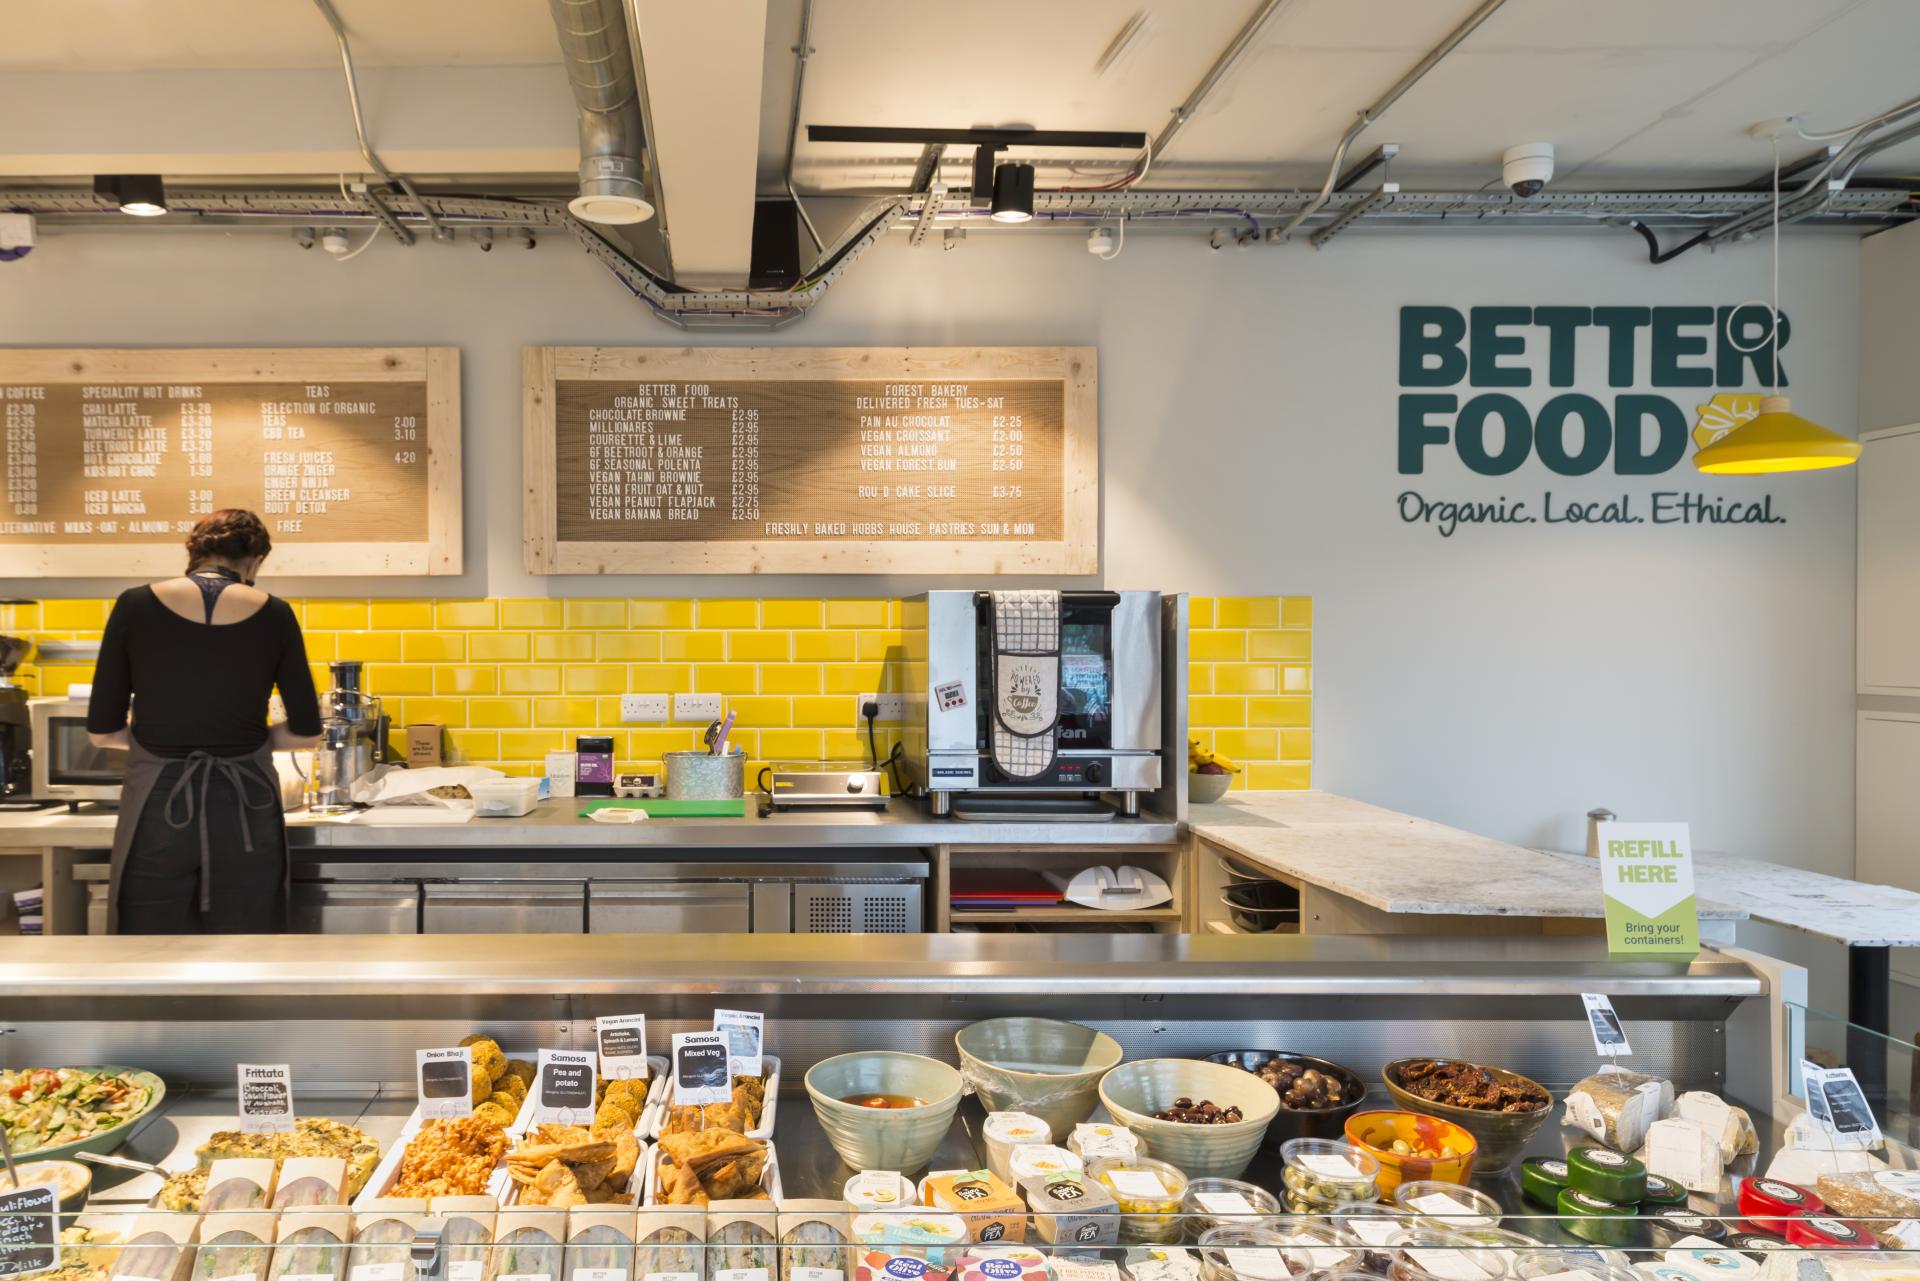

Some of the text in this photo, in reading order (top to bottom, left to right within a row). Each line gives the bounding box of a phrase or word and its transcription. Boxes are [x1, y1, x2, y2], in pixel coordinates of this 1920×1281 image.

[1399, 306, 1791, 388] BETTER
[6, 386, 45, 400] COFFEE
[82, 386, 139, 399] SPECIALITY
[168, 386, 203, 399] DRINKS
[306, 386, 329, 398] TEAS
[639, 384, 709, 396] BETTER FOOD
[886, 385, 968, 396] FOREST BAKERY
[109, 403, 137, 415] LATTE
[261, 402, 376, 414] SELECTION OF ORGANIC
[614, 397, 739, 409] ORGANIC SWEET TREATS
[856, 397, 1005, 409] DELIVERED FRESH TUES-SAT
[262, 415, 287, 427] TEAS
[589, 409, 759, 421] CHOCOLATE BROWNIE £2.95
[83, 416, 121, 427] MATCHA
[123, 416, 152, 427] LATTE
[589, 422, 759, 433] MILLIONARES £2.95
[861, 416, 1022, 427] PAIN AU CHOCOLAT £2.25
[85, 428, 135, 440] TURMERIC
[138, 428, 168, 440] LATTE
[288, 427, 304, 439] TEA
[861, 430, 891, 442] VEGAN
[896, 430, 950, 442] CROISSANT
[1397, 393, 1689, 476] FOOD
[589, 434, 759, 445] COURGETTE & LIME £2.95
[84, 441, 134, 452] BEETROOT
[138, 441, 168, 452] LATTE
[589, 446, 759, 458] GF BEETROOT & ORANGE £2.95
[861, 444, 891, 456] VEGAN
[897, 444, 938, 456] ALMOND
[263, 452, 295, 464] FRESH
[297, 452, 334, 464] JUICES
[264, 464, 300, 476] ORANGE
[589, 459, 759, 470] GF SEASONAL POLENTA £2.95
[861, 459, 891, 471] VEGAN
[896, 459, 933, 471] FOREST
[938, 459, 957, 471] BUN
[264, 477, 329, 489] GINGER NINJA
[589, 471, 759, 483] VEGAN TAHINI BROWNIE £2.95
[264, 489, 350, 501] GREEN CLEANSER
[589, 484, 759, 495] VEGAN FRUIT OAT & NUT £2.95
[896, 486, 921, 498] CAKE
[928, 486, 957, 498] SLICE
[112, 490, 142, 502] LATTE
[589, 496, 759, 508] VEGAN PEANUT FLAPJACK £2.75
[264, 502, 327, 514] ROOT DETOX
[589, 508, 620, 520] VEGAN
[668, 508, 699, 520] BREAD
[732, 508, 760, 520] £2.50
[1396, 491, 1787, 538] Organic. Local. Ethical.
[0, 521, 57, 534] LTERNATIVE
[277, 520, 303, 532] FREE
[765, 523, 808, 535] FRESHLY
[815, 523, 846, 535] BAKED
[852, 523, 883, 535] HOBBS
[889, 523, 920, 535] HOUSE
[929, 523, 975, 535] PASTRIES
[981, 523, 1000, 535] SUN
[1014, 523, 1034, 535] MON
[1010, 672, 1041, 685] POWERED
[1608, 839, 1684, 858] REFILL
[1618, 865, 1678, 883] HERE
[1626, 922, 1680, 935] Bring your
[1624, 935, 1684, 945] containers!
[685, 1036, 719, 1044] Samosa
[551, 1053, 586, 1062] Samosa
[685, 1049, 720, 1058] Mixed Veg
[246, 1068, 284, 1078] Frittata
[568, 1069, 582, 1077] and
[555, 1080, 579, 1088] potato
